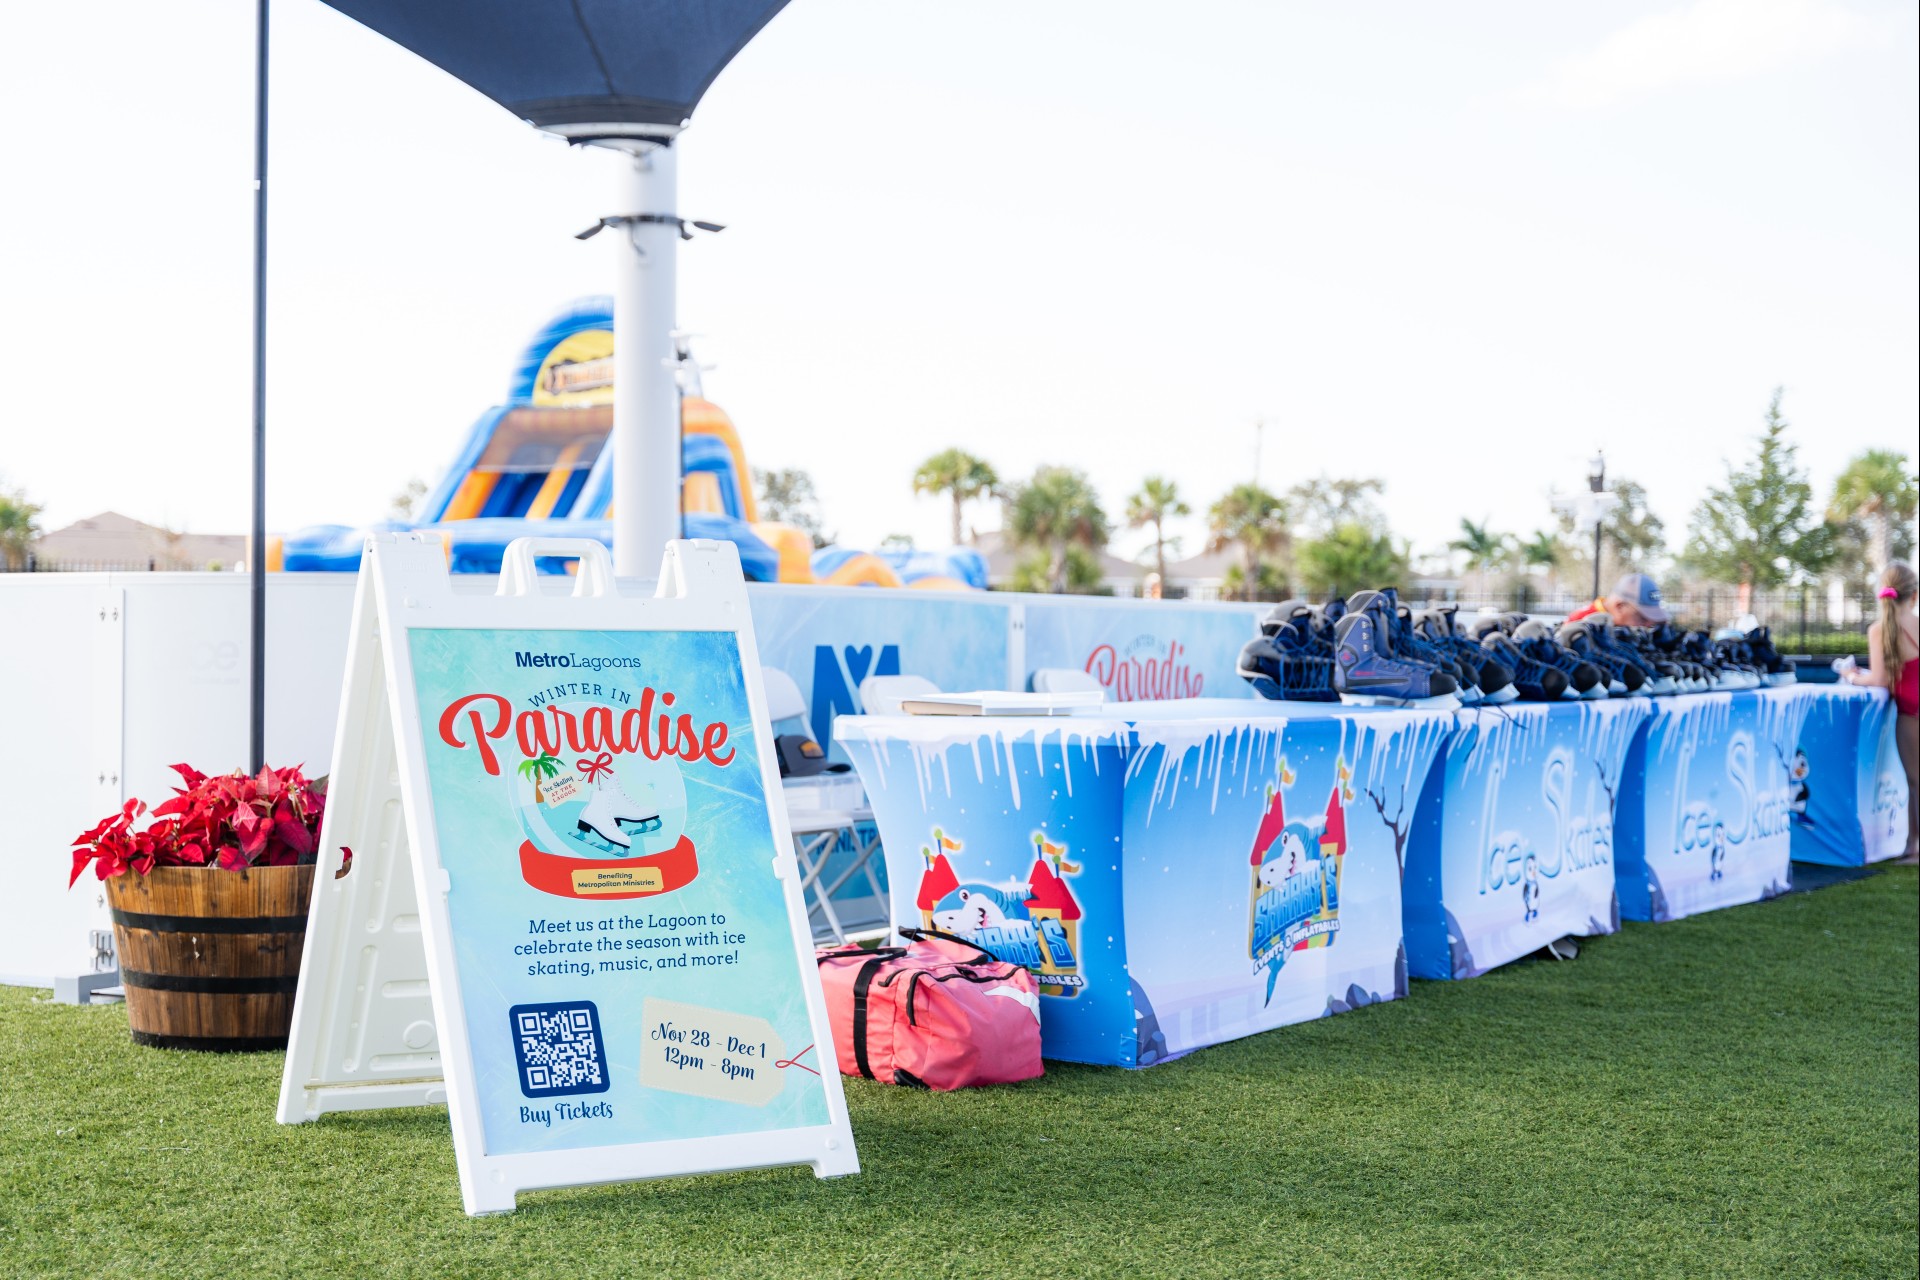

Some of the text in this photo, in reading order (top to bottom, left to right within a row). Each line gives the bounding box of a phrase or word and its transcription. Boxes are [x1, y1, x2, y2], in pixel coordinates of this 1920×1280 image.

[514, 651, 641, 671] MetroLagoons
[528, 683, 631, 708] WINTER IN
[438, 686, 737, 776] Paradise
[551, 784, 573, 797] AT THE
[553, 776, 574, 789] Skating
[552, 788, 577, 803] LAGOON
[1672, 741, 1711, 854] Ice
[1478, 745, 1613, 895] Ice Skates
[578, 879, 655, 889] Metropolitan Ministries
[528, 913, 726, 934] Meet us at the Lagoon to
[514, 931, 746, 956] celebrate the season with ice
[1253, 940, 1285, 975] EVENTS
[1293, 918, 1340, 944] INFLATABLES
[528, 950, 739, 976] skating, music, and more!
[651, 1022, 687, 1043] Nov
[691, 1029, 710, 1047] 28
[727, 1036, 755, 1056] Dec
[760, 1042, 766, 1058] 1
[664, 1046, 703, 1070] 12pm
[721, 1058, 755, 1080] 8pm
[520, 1101, 613, 1127] Buy Tickets
